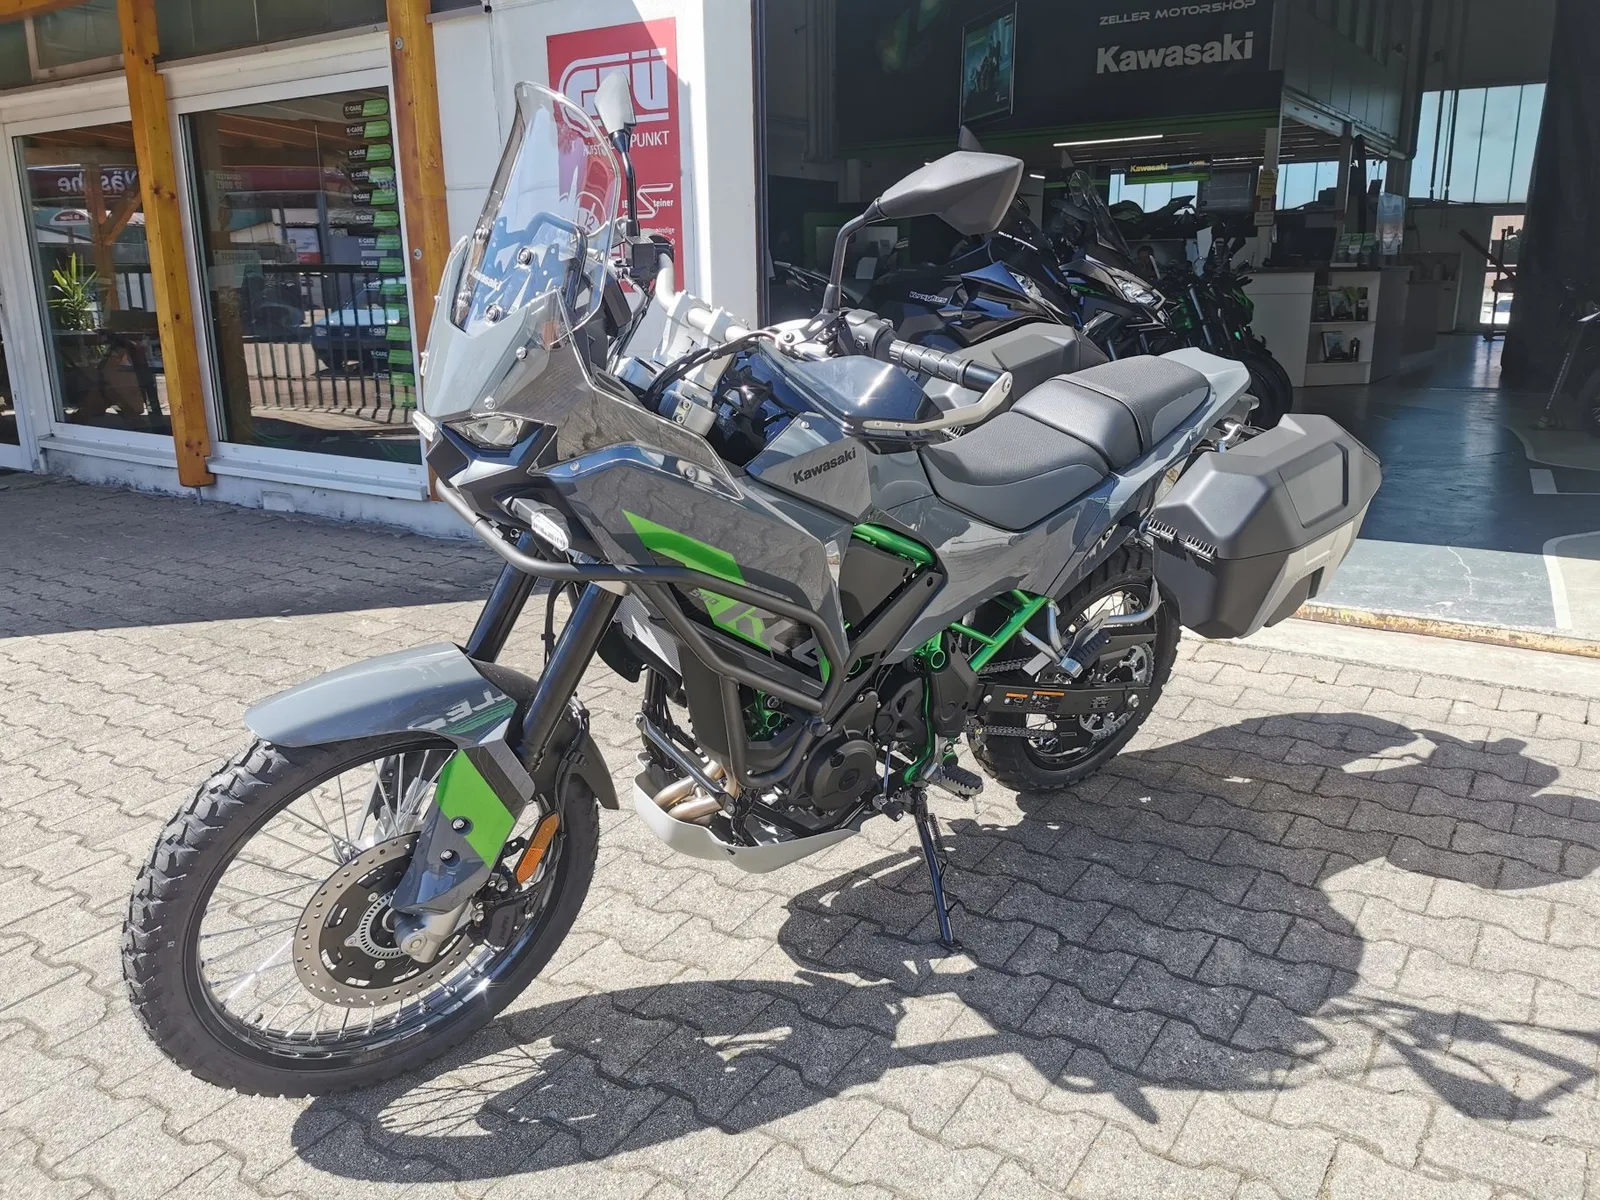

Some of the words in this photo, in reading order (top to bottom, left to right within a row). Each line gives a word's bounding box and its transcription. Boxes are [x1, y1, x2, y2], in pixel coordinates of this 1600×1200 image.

[1098, 11, 1151, 26] ZELLER
[1154, 0, 1257, 20] MOTORSHOP
[1096, 31, 1254, 74] Kawasaki
[1130, 162, 1168, 173] Kawasaki
[360, 259, 378, 267] K-CARE
[793, 447, 857, 485] Kawasaki
